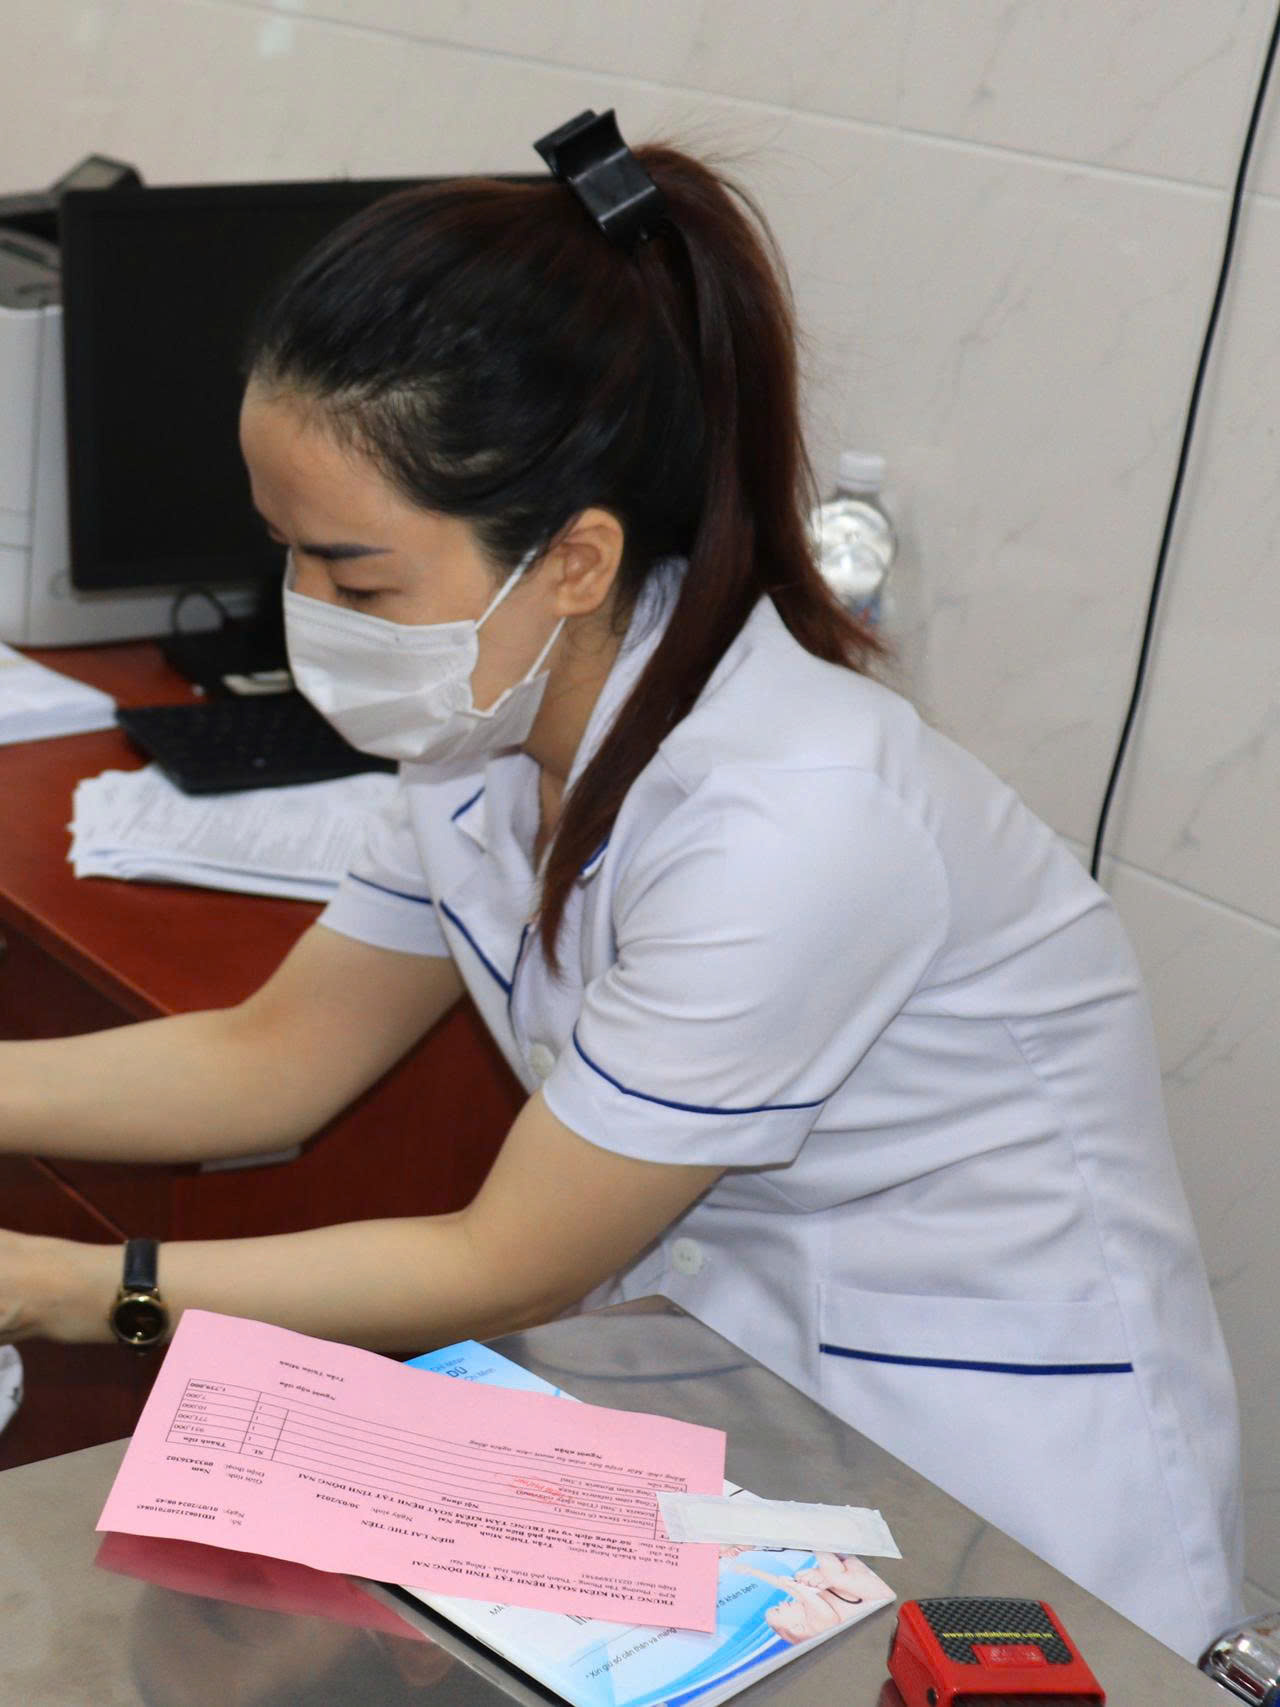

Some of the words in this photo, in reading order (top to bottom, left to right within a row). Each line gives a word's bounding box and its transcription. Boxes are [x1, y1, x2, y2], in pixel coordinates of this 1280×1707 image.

[298, 1473, 315, 1482] NAI
[387, 1525, 408, 1534] THU
[516, 1577, 545, 1587] BỆNH
[548, 1583, 576, 1592] SOÁT
[610, 1592, 634, 1600] TÂM
[636, 1596, 673, 1605] TRUNG
